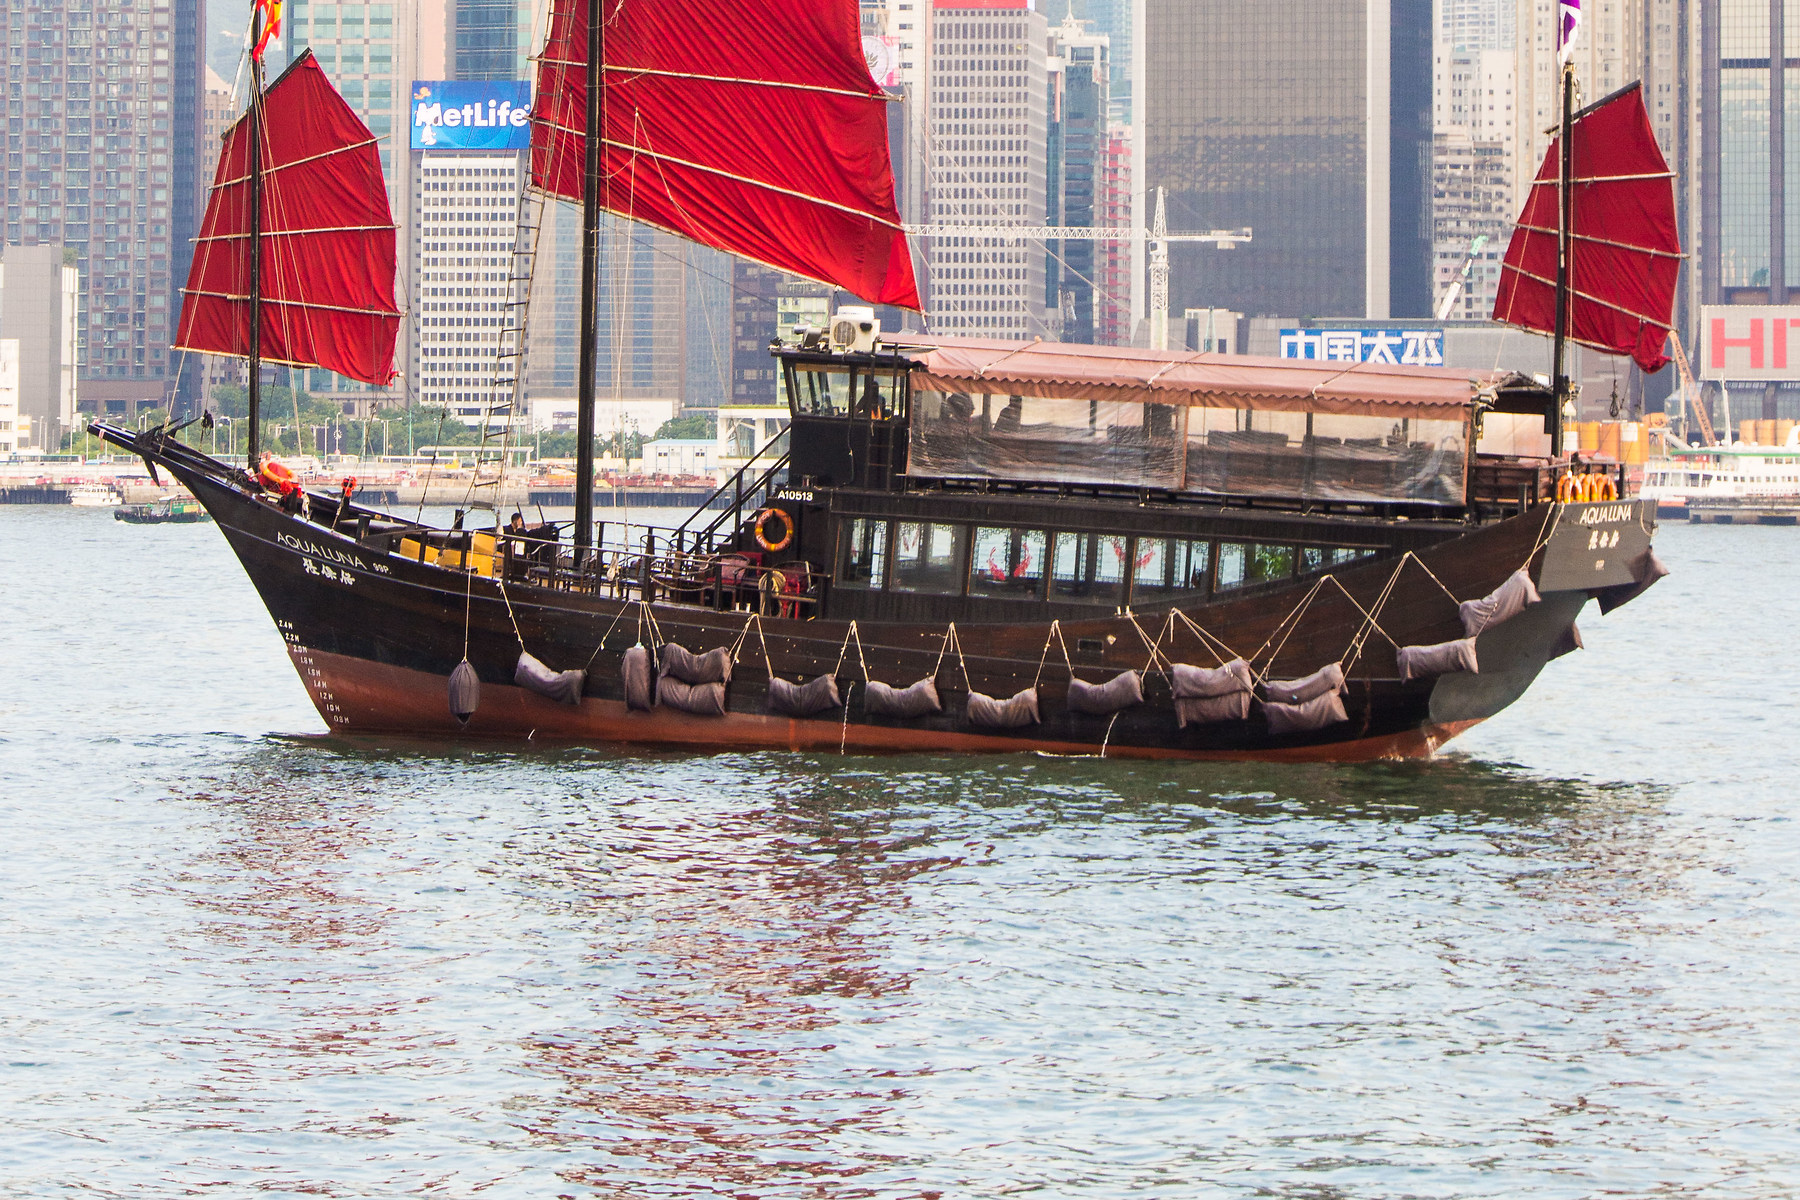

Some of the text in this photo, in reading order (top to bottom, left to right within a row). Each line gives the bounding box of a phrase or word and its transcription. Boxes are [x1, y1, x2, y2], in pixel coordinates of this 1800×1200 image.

[415, 99, 529, 127] MetLife
[1280, 330, 1443, 367] 中国太平
[1711, 318, 1800, 369] HI
[777, 490, 814, 501] A10513
